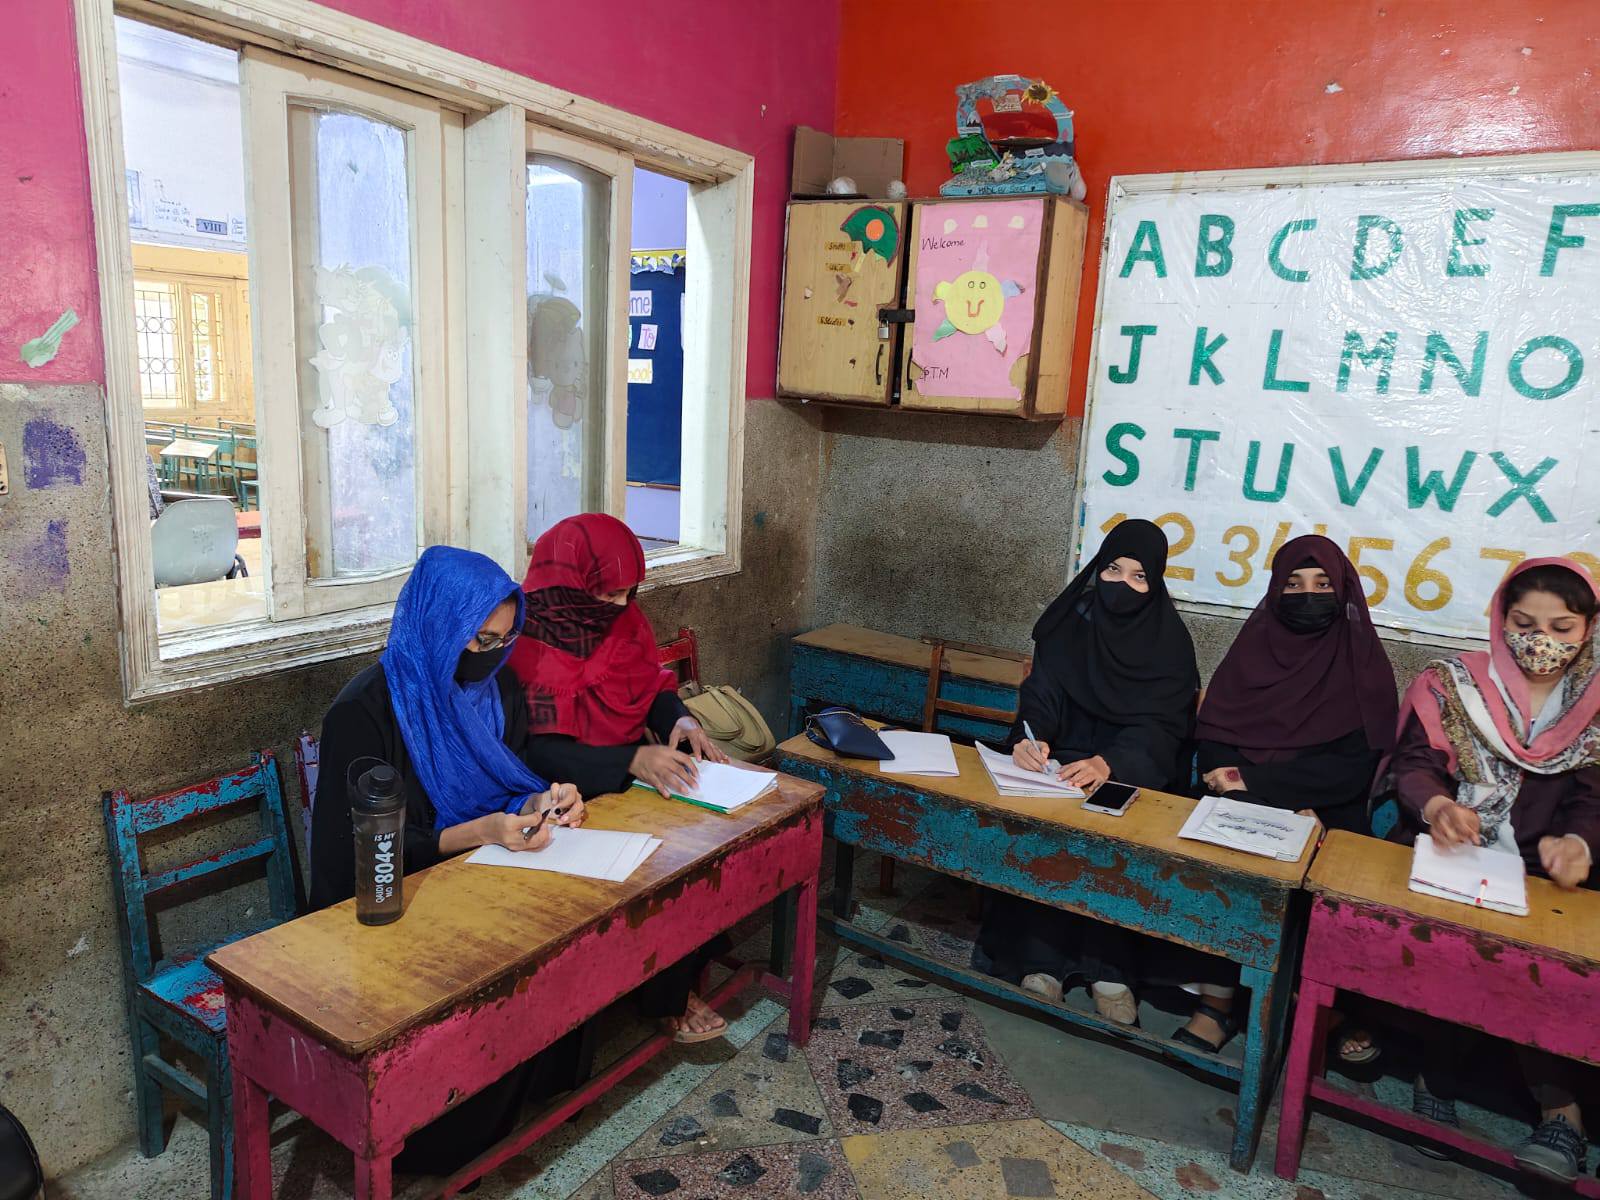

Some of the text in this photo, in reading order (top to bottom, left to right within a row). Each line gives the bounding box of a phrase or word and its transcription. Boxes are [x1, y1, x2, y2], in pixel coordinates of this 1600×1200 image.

[203, 222, 222, 233] VIII
[922, 236, 965, 250] Welcome
[1119, 203, 1600, 283] A B C D E F
[629, 297, 650, 314] me
[1108, 325, 1585, 401] J K L M N O
[1102, 422, 1558, 523] S T U V W X
[1154, 512, 1195, 581] 2
[1216, 525, 1259, 587] 3
[1347, 537, 1393, 607] 5
[1404, 537, 1453, 611] 6
[384, 832, 396, 840] MY
[375, 852, 394, 883] 804
